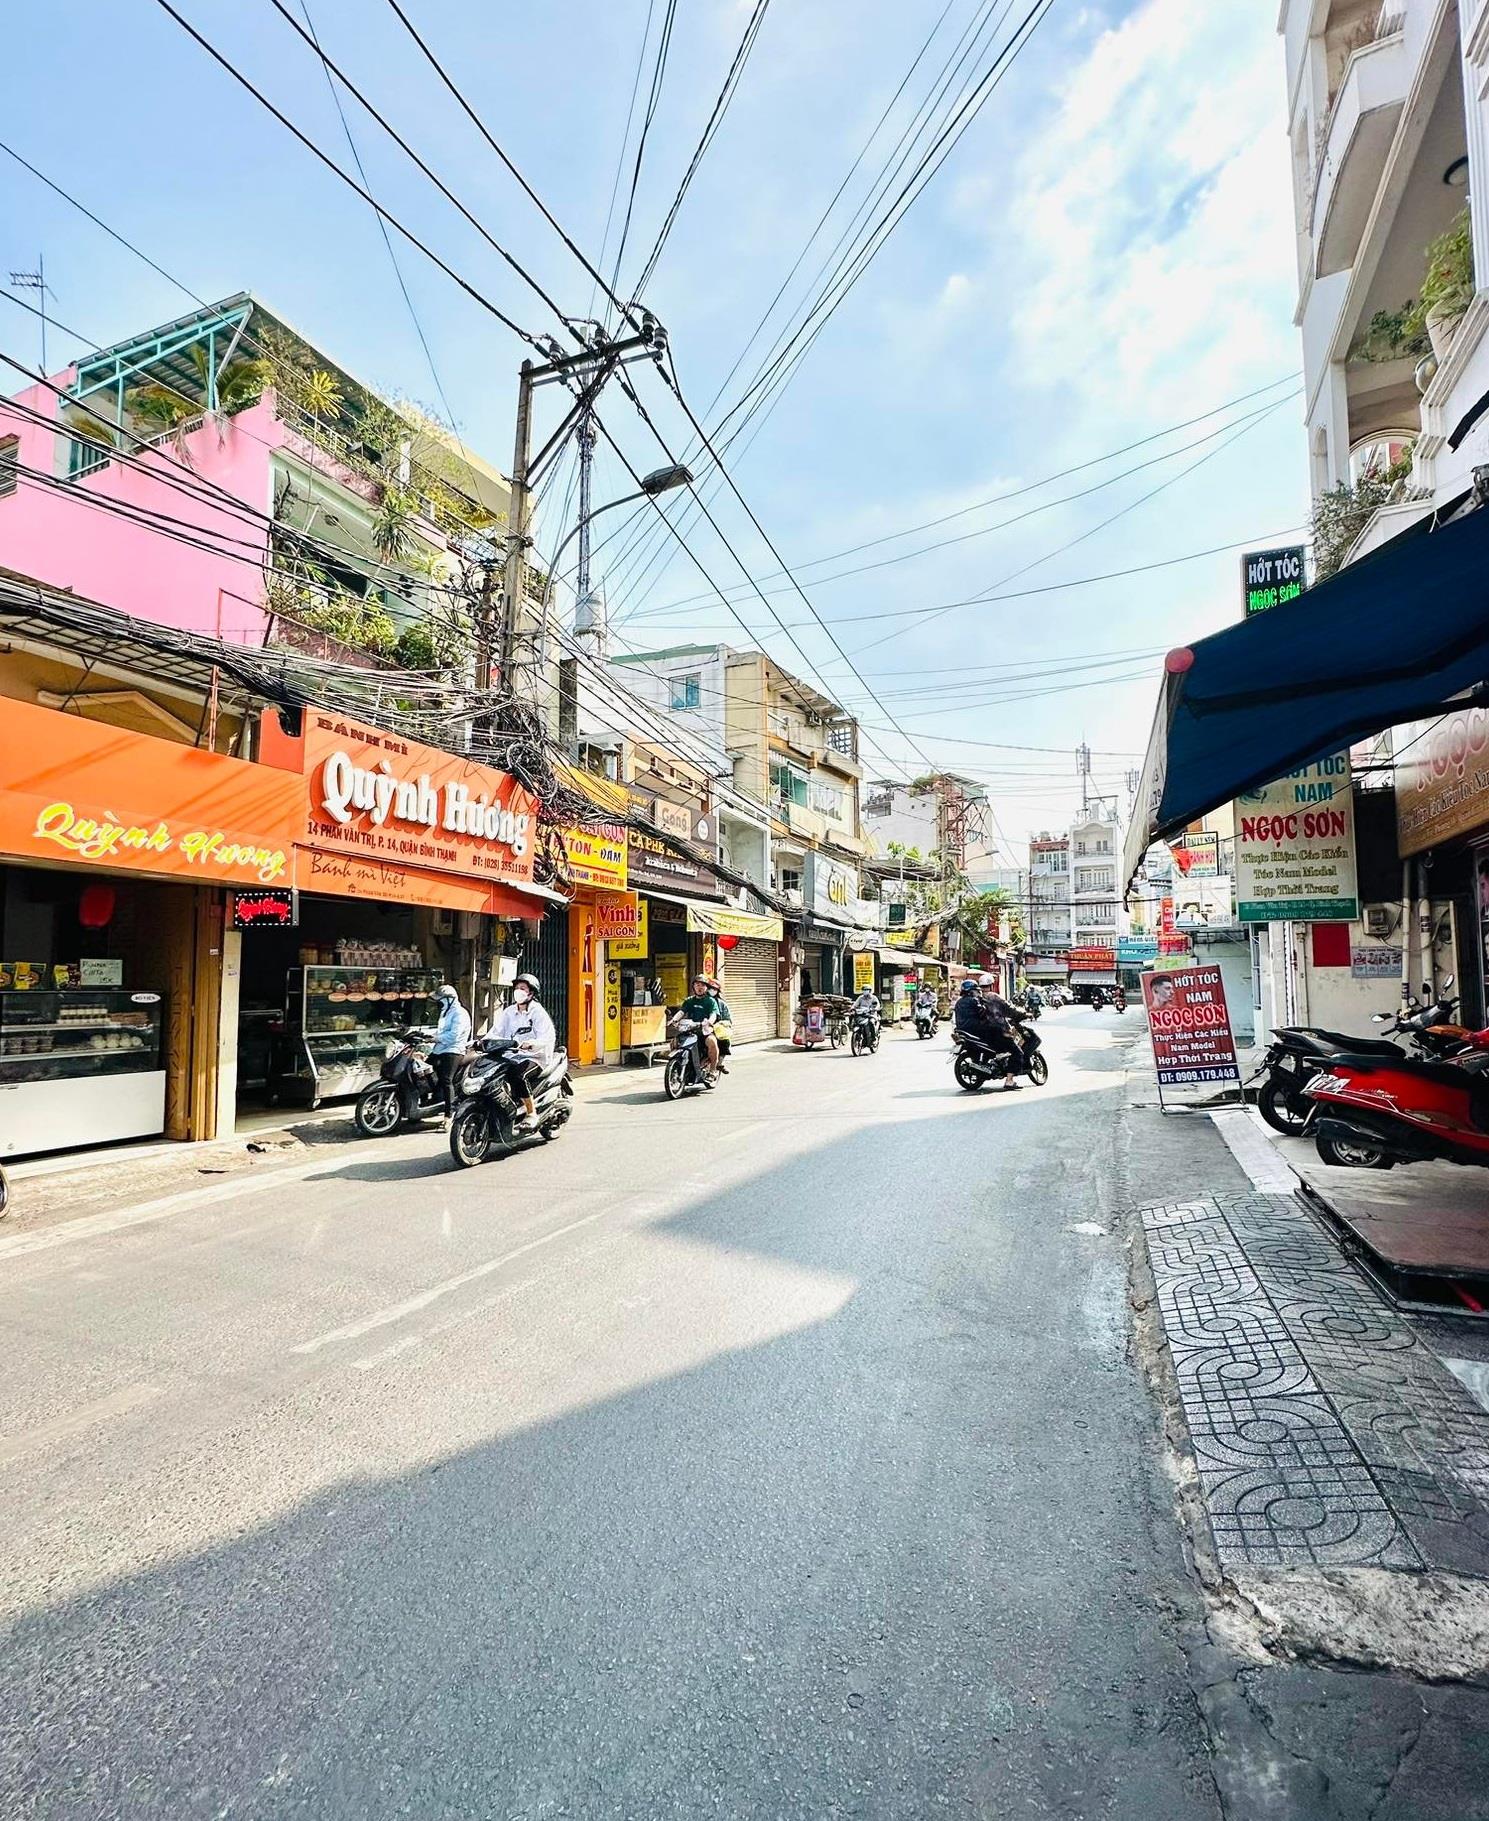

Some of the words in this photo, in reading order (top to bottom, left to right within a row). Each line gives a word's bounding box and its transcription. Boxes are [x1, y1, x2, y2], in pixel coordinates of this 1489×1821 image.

[1248, 557, 1273, 584] HỚT
[1274, 553, 1300, 580] TÓC
[317, 717, 380, 747] BÁNH
[384, 739, 408, 755] MÌ
[321, 751, 437, 826] Quỳnh
[1294, 782, 1333, 802] NAM
[33, 802, 173, 859] Quỳnh
[307, 821, 318, 835] 14
[378, 836, 385, 848] P.
[387, 838, 398, 852] 14,
[1240, 814, 1298, 848] NGỌC
[1303, 806, 1346, 838] SƠN
[311, 851, 351, 878] Bánh
[356, 867, 377, 880] mì
[380, 863, 407, 888] Việt
[1275, 867, 1302, 879] Nam
[1303, 865, 1337, 877] Model
[1304, 883, 1340, 895] Trang
[1174, 975, 1195, 988] HỚT
[1196, 972, 1219, 985] TÓC
[1186, 990, 1213, 1004] NAM
[1149, 1007, 1192, 1032] NGỌC
[1193, 1002, 1227, 1026] SƠN
[1154, 1034, 1174, 1043] Thực
[1194, 1030, 1209, 1039] Các
[1170, 1044, 1189, 1052] Nam
[1190, 1041, 1216, 1051] Model
[1157, 1055, 1178, 1066] Hợp
[1203, 1052, 1233, 1062] Trang
[1160, 1072, 1174, 1083] ĐT:
[1175, 1067, 1236, 1082] 0909.179.448
